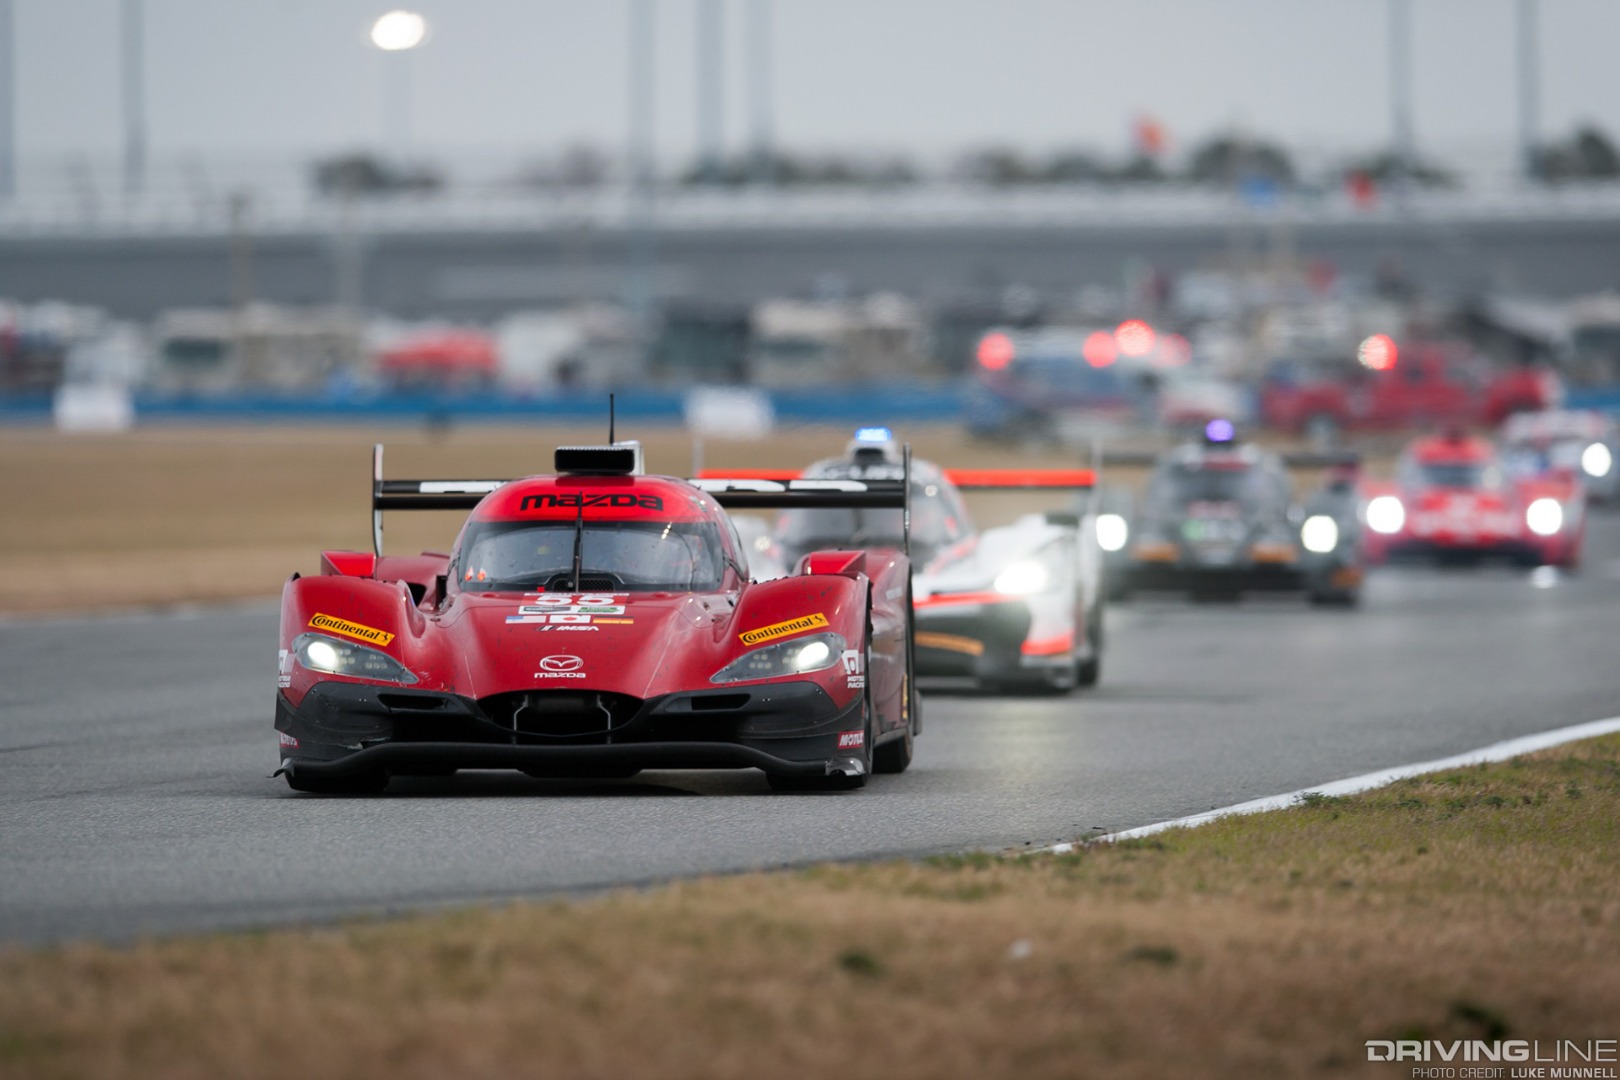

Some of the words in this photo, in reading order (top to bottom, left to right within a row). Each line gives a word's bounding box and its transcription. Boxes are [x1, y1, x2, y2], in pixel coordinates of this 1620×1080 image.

[535, 594, 615, 605] 55
[311, 615, 382, 641] Continental
[742, 618, 814, 643] Continental
